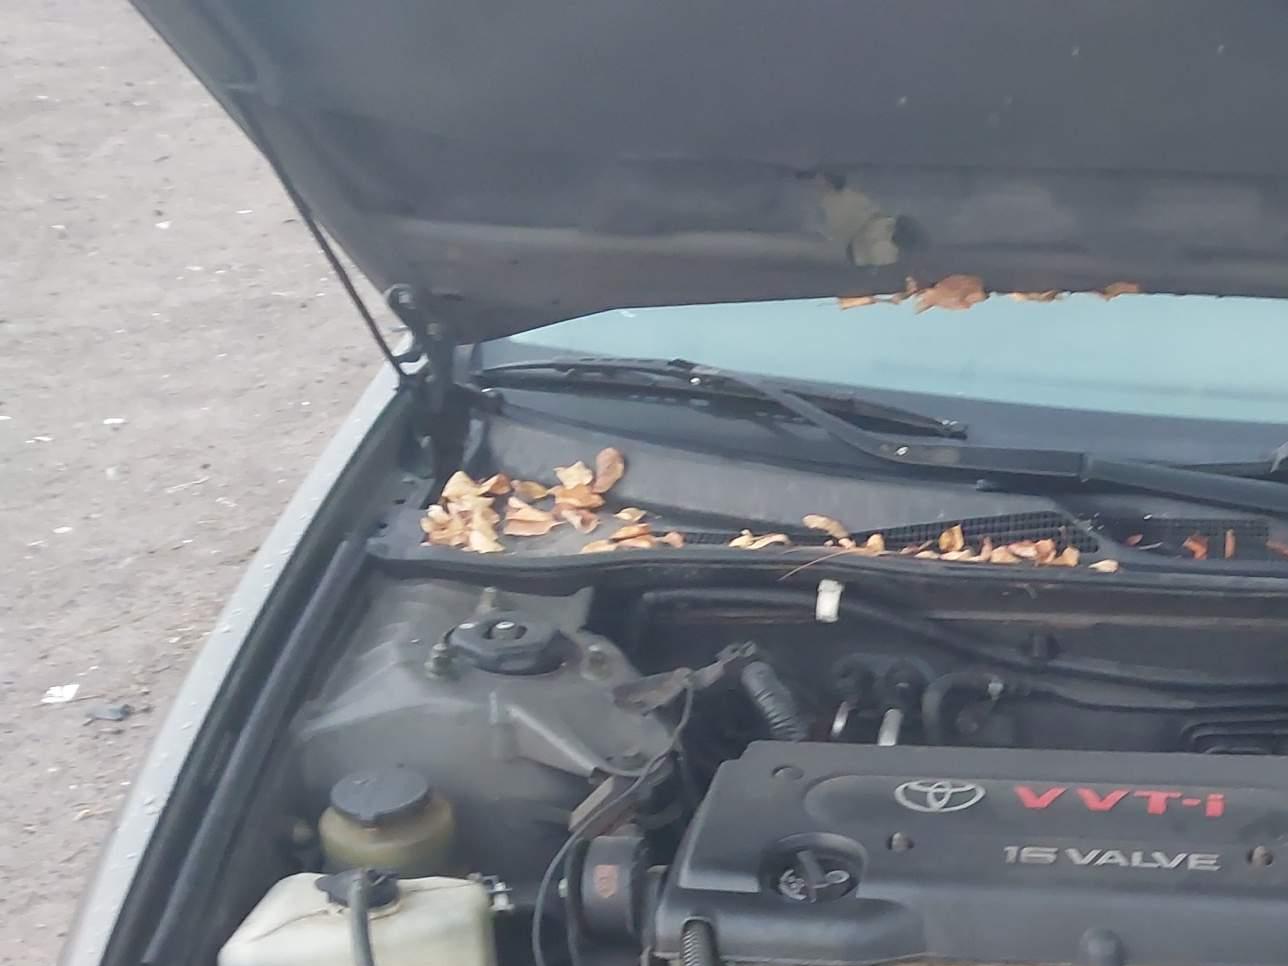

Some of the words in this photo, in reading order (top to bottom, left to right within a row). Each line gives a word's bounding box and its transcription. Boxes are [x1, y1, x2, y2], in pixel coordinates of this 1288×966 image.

[1012, 784, 1226, 818] VVT-i
[1003, 845, 1060, 866] 16
[1063, 847, 1223, 872] VALVE
